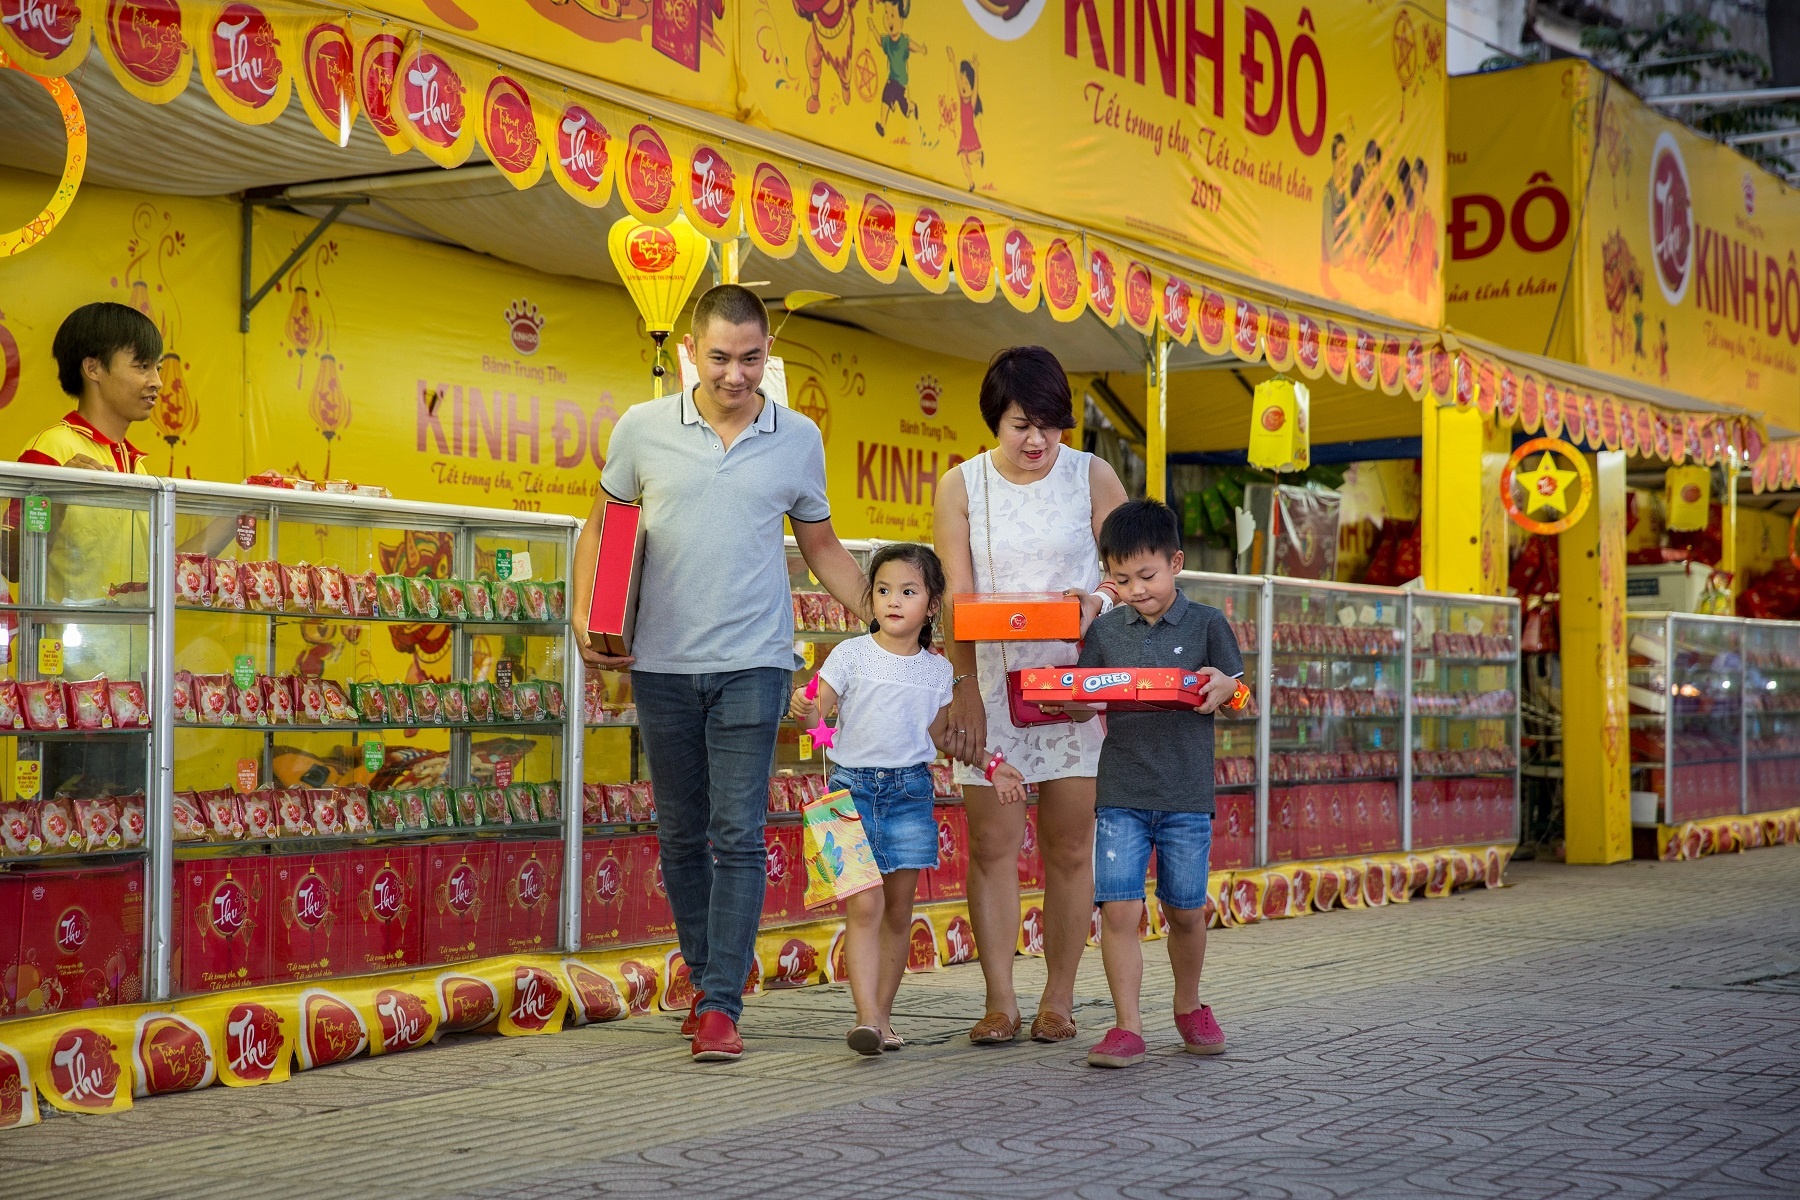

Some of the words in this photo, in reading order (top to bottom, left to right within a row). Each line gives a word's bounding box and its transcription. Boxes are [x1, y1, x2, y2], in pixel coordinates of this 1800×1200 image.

[126, 2, 160, 34] Trăng
[216, 16, 278, 96] Thu
[1240, 7, 1327, 156] ĐÔ
[408, 63, 461, 138] Thu
[1084, 81, 1120, 129] Tết
[1125, 108, 1163, 157] trung
[1168, 119, 1192, 160] thu,
[1198, 126, 1229, 171] Tết
[560, 115, 604, 182] Thu
[692, 155, 730, 218] Thu
[1190, 176, 1223, 213] 2017
[811, 188, 843, 247] Thu
[1447, 171, 1570, 262] ĐÔ
[914, 214, 942, 270] Thu
[1005, 236, 1033, 290] Thu
[1092, 259, 1113, 308] Thu
[1447, 284, 1469, 303] ủa
[1695, 222, 1759, 331] KINH
[1764, 249, 1800, 346] ĐÔ
[482, 355, 511, 374] Bánh
[514, 360, 544, 384] Trung
[547, 365, 567, 384] Thu
[417, 379, 539, 466] KINH
[900, 419, 919, 436] Bánh
[921, 423, 941, 441] Trung
[943, 426, 957, 441] Thu
[432, 462, 457, 485] Tết
[461, 473, 490, 493] trung
[518, 471, 543, 494] Tết
[857, 440, 938, 507] KINH
[512, 499, 541, 513] 2017
[1084, 673, 1131, 697] OREO
[374, 877, 400, 911] Thu
[450, 872, 473, 905] Thu
[519, 868, 542, 899] Thu
[597, 865, 619, 894] Thu
[214, 890, 243, 926] Thu
[298, 884, 325, 918] Thu
[59, 915, 86, 944] Thu
[1023, 912, 1043, 953] Thu
[1091, 906, 1102, 943] Th
[509, 969, 554, 1020] Thu
[316, 1017, 344, 1040] Trăng
[379, 995, 427, 1046] Thu
[151, 1042, 186, 1065] Trăng
[229, 1009, 278, 1070] Thu
[329, 1034, 347, 1057] Vàng
[54, 1036, 118, 1101] Thu
[167, 1058, 190, 1084] Vàng
